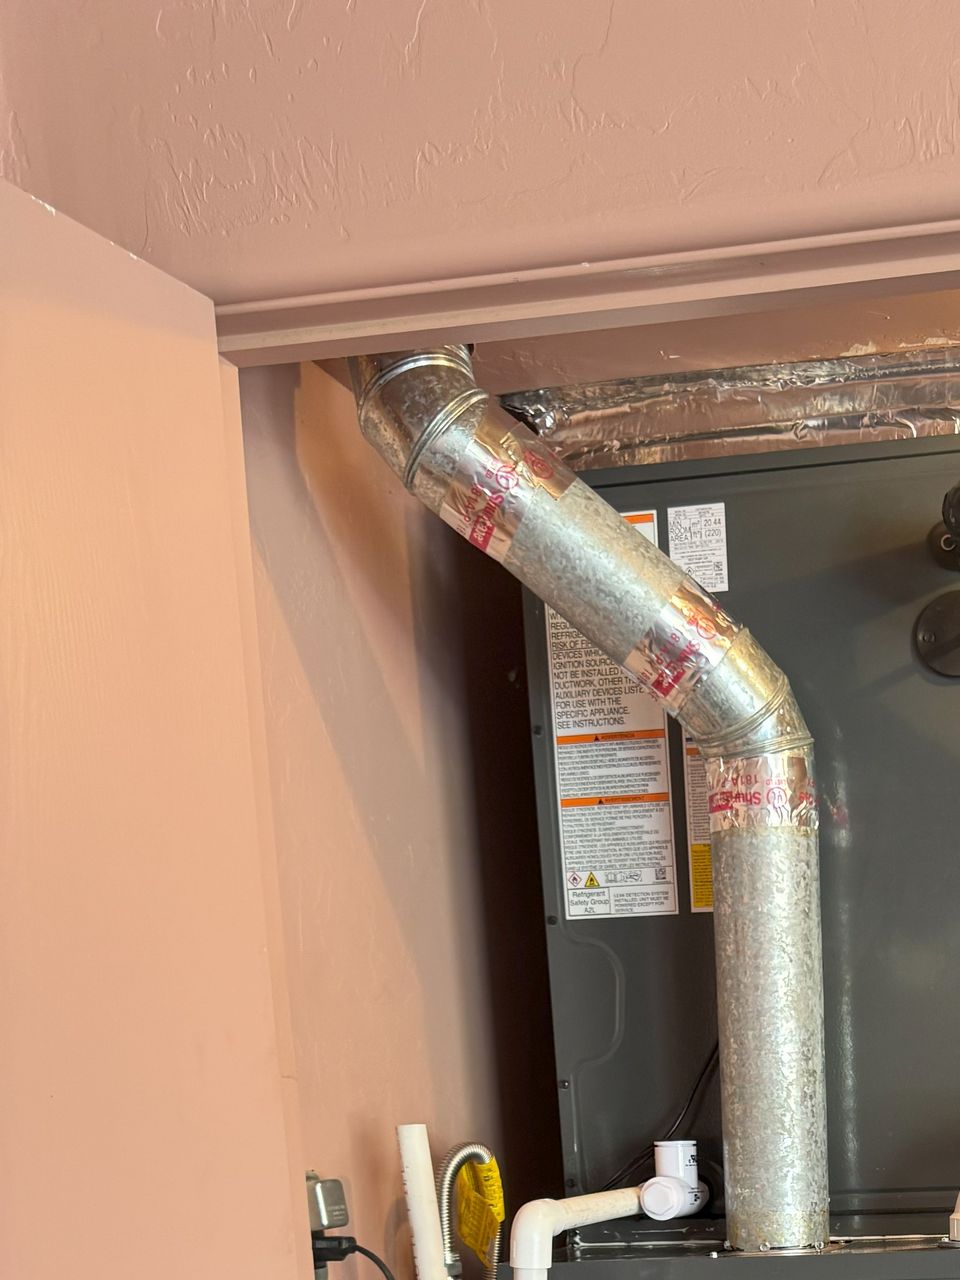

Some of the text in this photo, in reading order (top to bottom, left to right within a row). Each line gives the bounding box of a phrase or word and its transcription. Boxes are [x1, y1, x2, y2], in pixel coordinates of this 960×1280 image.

[553, 650, 582, 660] DEVICES
[570, 670, 580, 678] BE
[580, 667, 620, 678] INSTALLED
[598, 676, 624, 688] OTHER
[592, 687, 623, 697] DEVICES
[556, 697, 622, 710] FOR USE WITH THE
[556, 711, 588, 720] SPECIFIC
[558, 721, 572, 730] SEE
